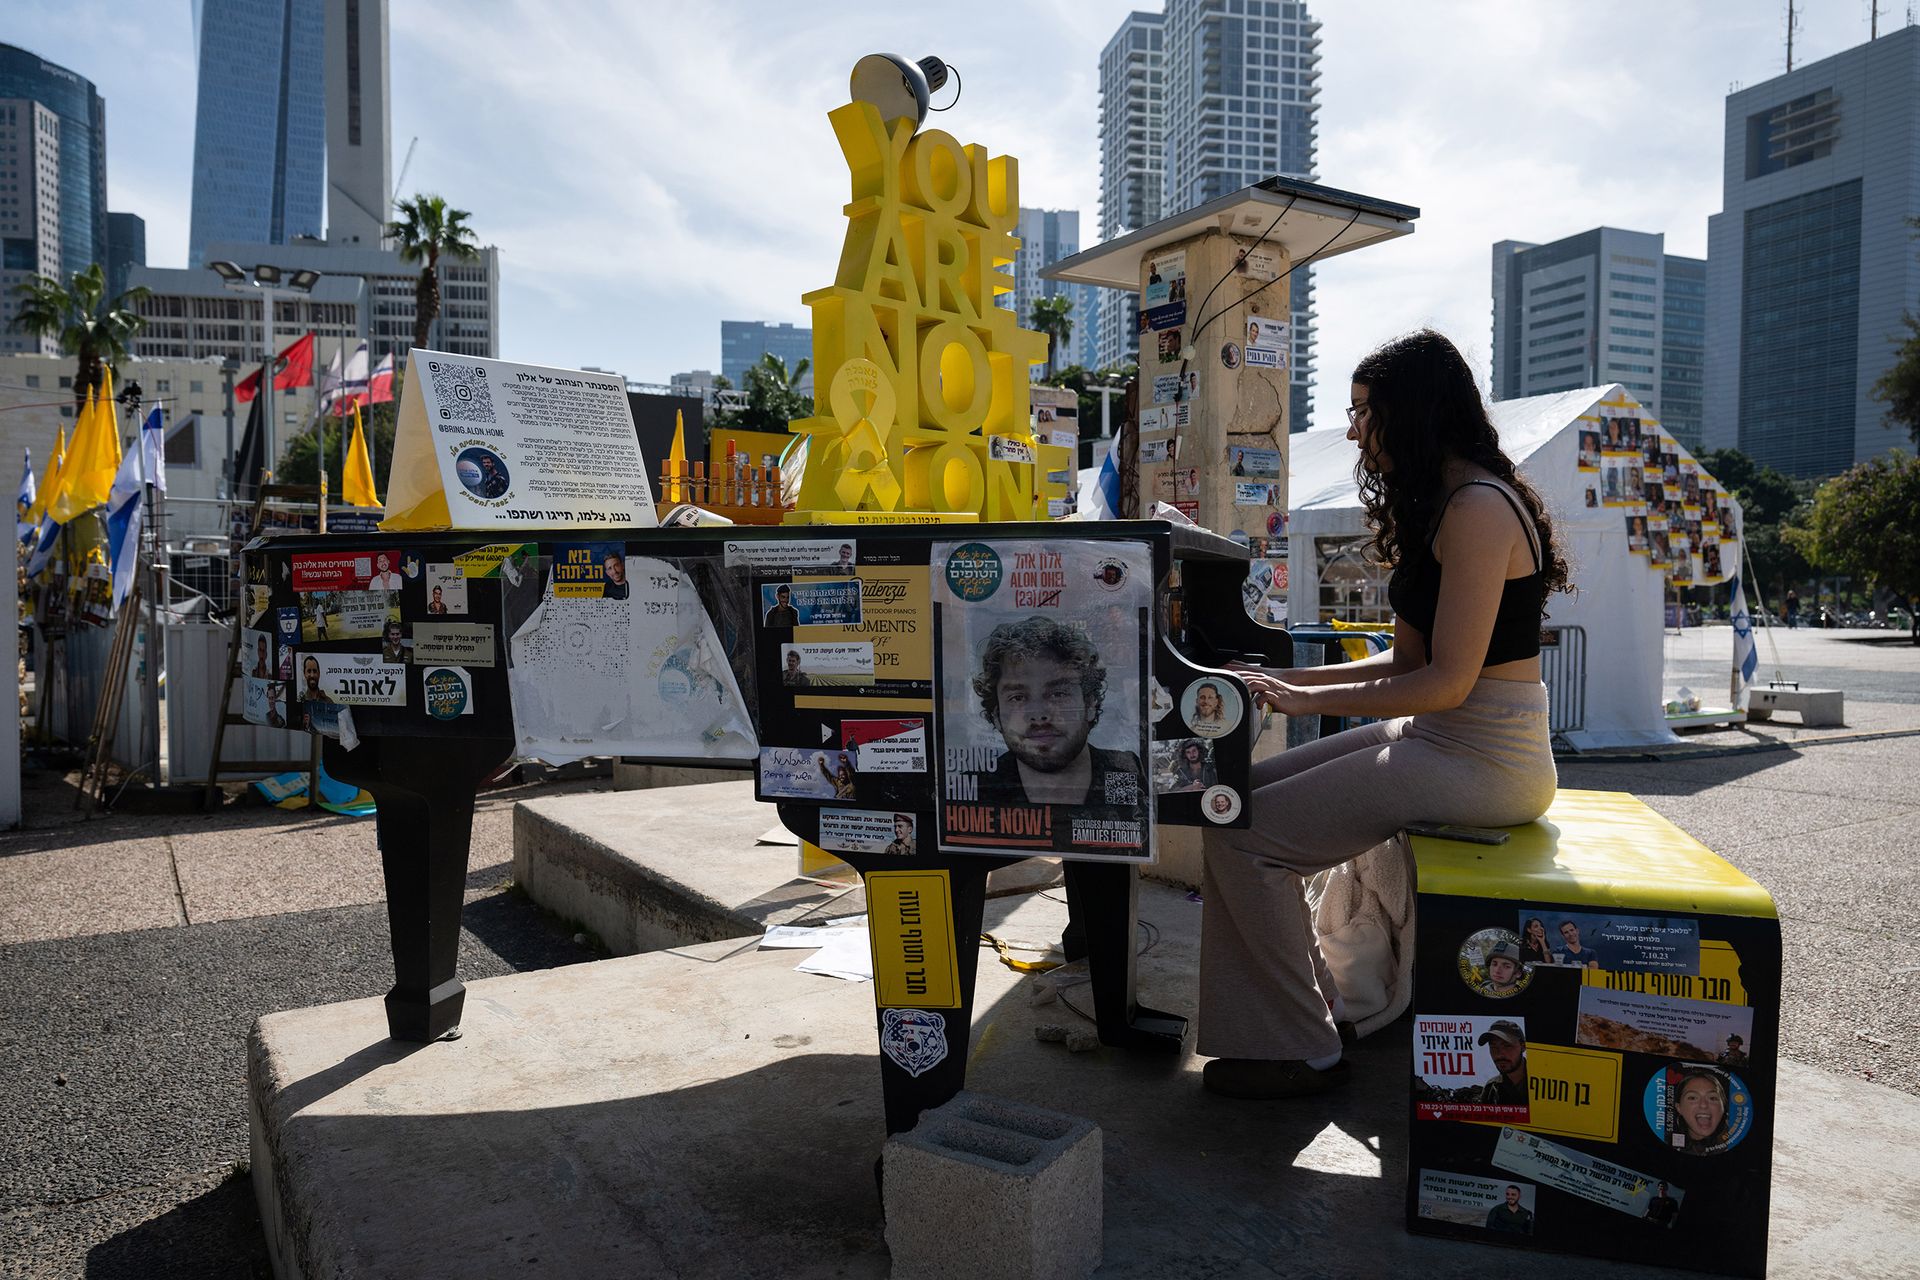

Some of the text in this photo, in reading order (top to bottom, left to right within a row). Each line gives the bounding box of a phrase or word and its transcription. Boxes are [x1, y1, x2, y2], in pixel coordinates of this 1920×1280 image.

[828, 100, 1019, 233] YOU
[835, 200, 1021, 318] ARE
[808, 300, 1050, 436] NOT
[516, 372, 620, 391] הפסנתר הצהוב של אלון
[438, 424, 505, 437] @BRING.ALON.HOME
[795, 424, 1078, 523] ALONE
[546, 511, 574, 521] תייגו
[577, 510, 606, 523] צלמו,
[608, 513, 631, 523] נגנו,
[568, 549, 591, 564] בוא
[1015, 551, 1036, 569] אהל
[1039, 551, 1062, 570] אלון
[302, 560, 318, 569] אליה
[318, 560, 328, 568] את
[328, 559, 354, 568] מחזירים
[950, 559, 998, 569] השבת
[322, 570, 342, 578] הביתה
[949, 569, 998, 579] חטופים
[1010, 571, 1037, 588] ALON
[1040, 571, 1067, 588] OHEL
[1015, 589, 1036, 608] (23)
[343, 667, 353, 675] את
[354, 666, 374, 675] לחפש
[375, 666, 404, 675] להקשיב,
[333, 676, 396, 696] לאהוב.
[428, 691, 465, 702] חטופים
[946, 746, 999, 773] BRING
[945, 774, 979, 801] HIM
[945, 804, 1053, 837] HOME NOW!
[1071, 819, 1141, 832] HOSTAGES AND MISSING
[1071, 828, 1142, 844] FAMILIES FORUM
[898, 890, 928, 995] חבר חטוף בעזה
[1626, 934, 1637, 942] את
[1641, 951, 1669, 960] 7.10.23
[1605, 970, 1732, 1001] חבר חטוף בעזה
[1419, 1021, 1473, 1034] לא שוכחים
[1421, 1035, 1473, 1051] את איתי
[1423, 1052, 1476, 1077] בעזה
[1529, 1076, 1591, 1106] בן חטוף
[1570, 1163, 1588, 1176] בדרך
[1448, 1178, 1476, 1188] לעשות
[1610, 1176, 1621, 1189] רק
[1621, 1182, 1636, 1192] הוא
[1460, 1188, 1484, 1199] אפשר
